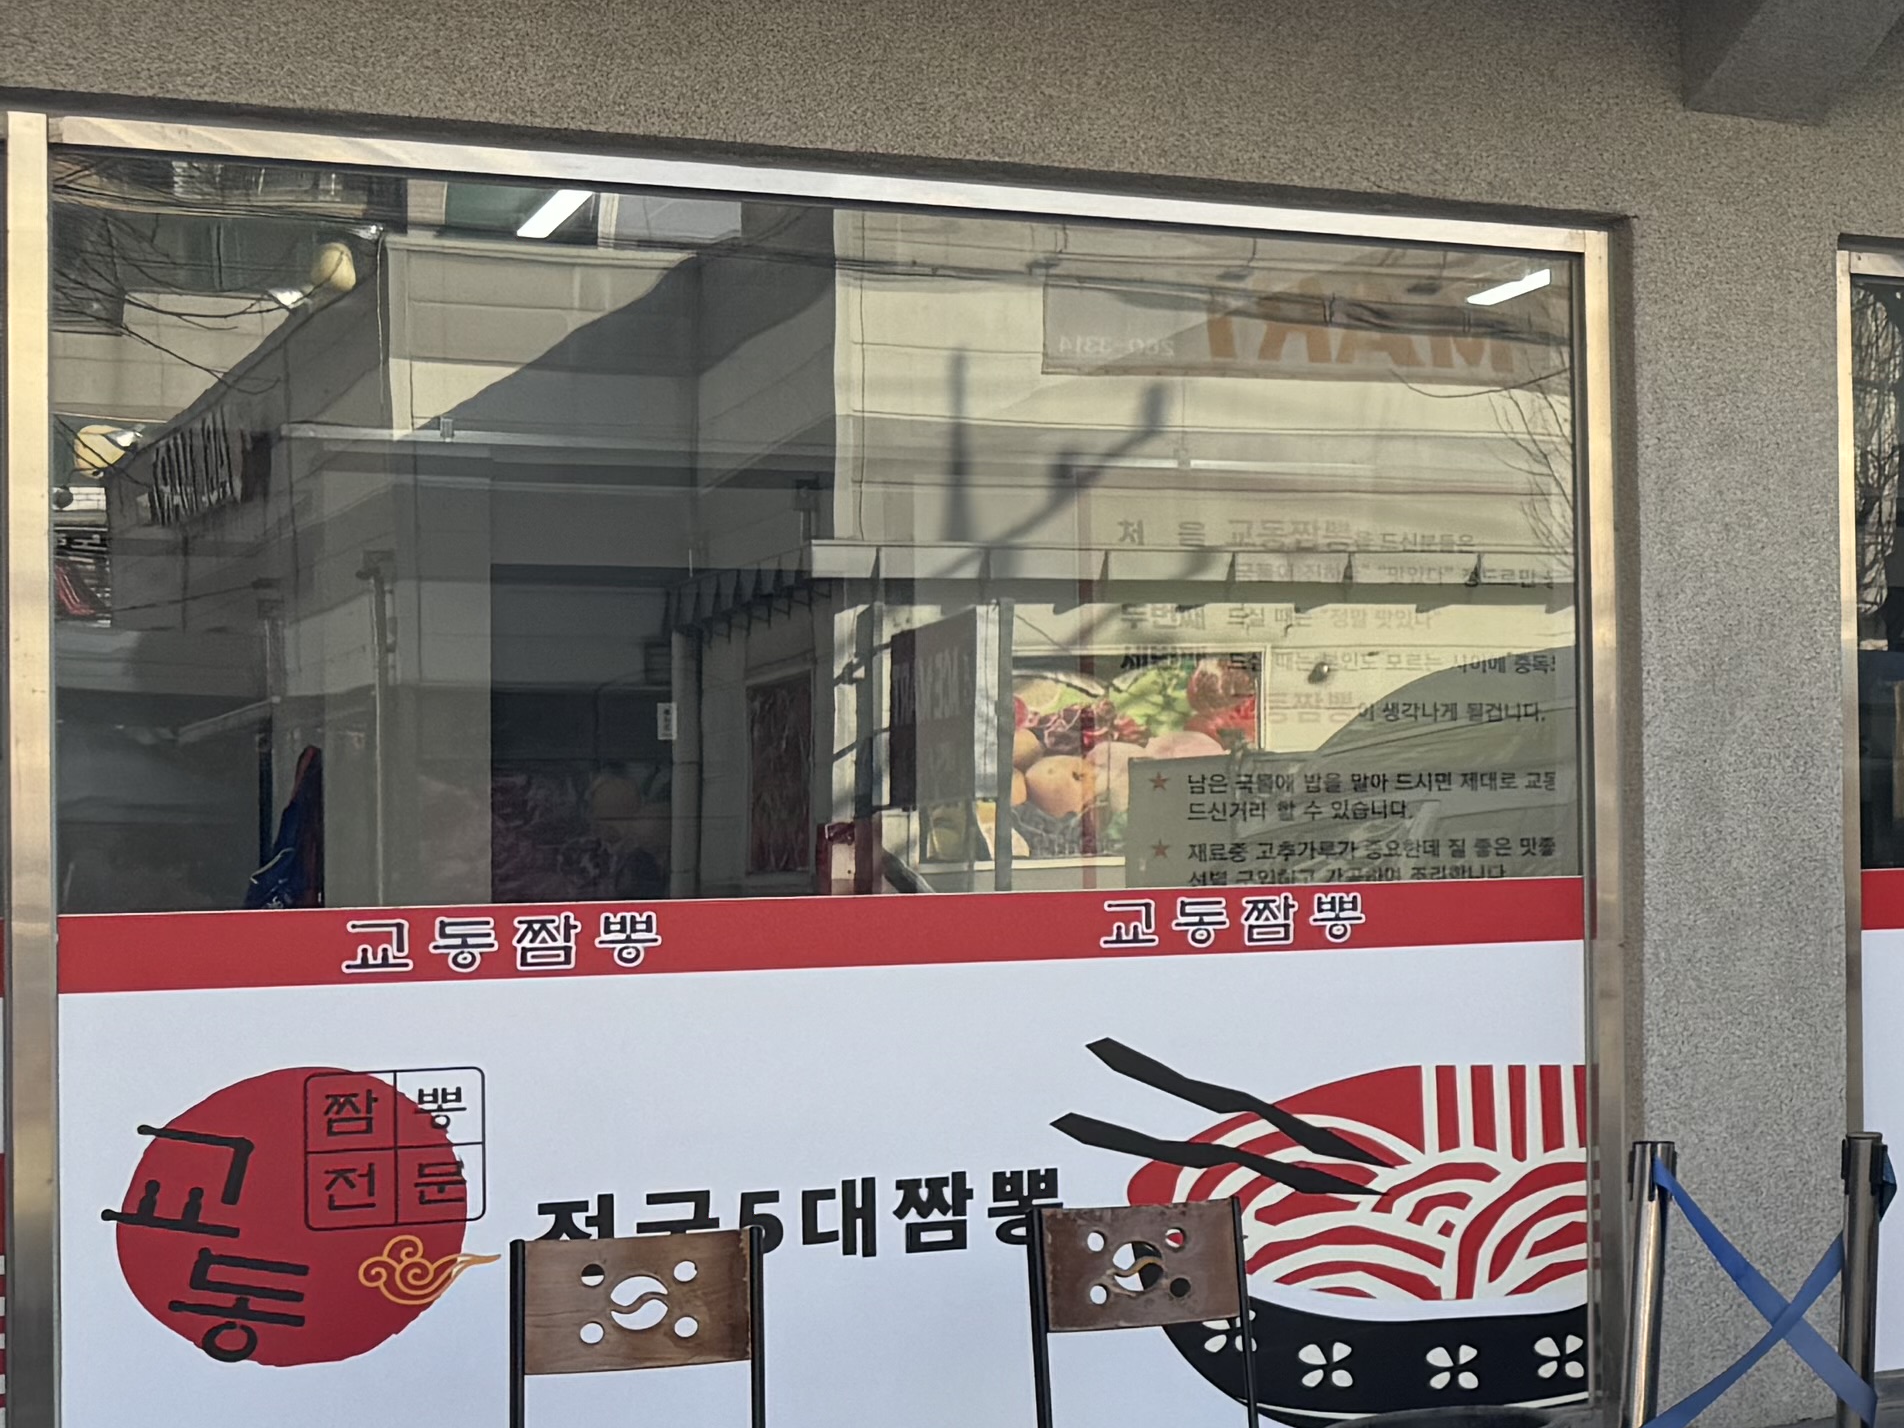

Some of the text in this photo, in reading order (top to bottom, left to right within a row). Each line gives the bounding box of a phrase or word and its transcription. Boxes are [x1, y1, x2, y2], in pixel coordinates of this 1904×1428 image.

[1187, 772, 1228, 795] 남은
[1394, 771, 1453, 793] 드시면
[1459, 771, 1518, 792] 제대로
[1303, 800, 1324, 822] 수
[1100, 890, 1368, 949] 교동짬뽕
[342, 909, 664, 976] 교동짬뽕
